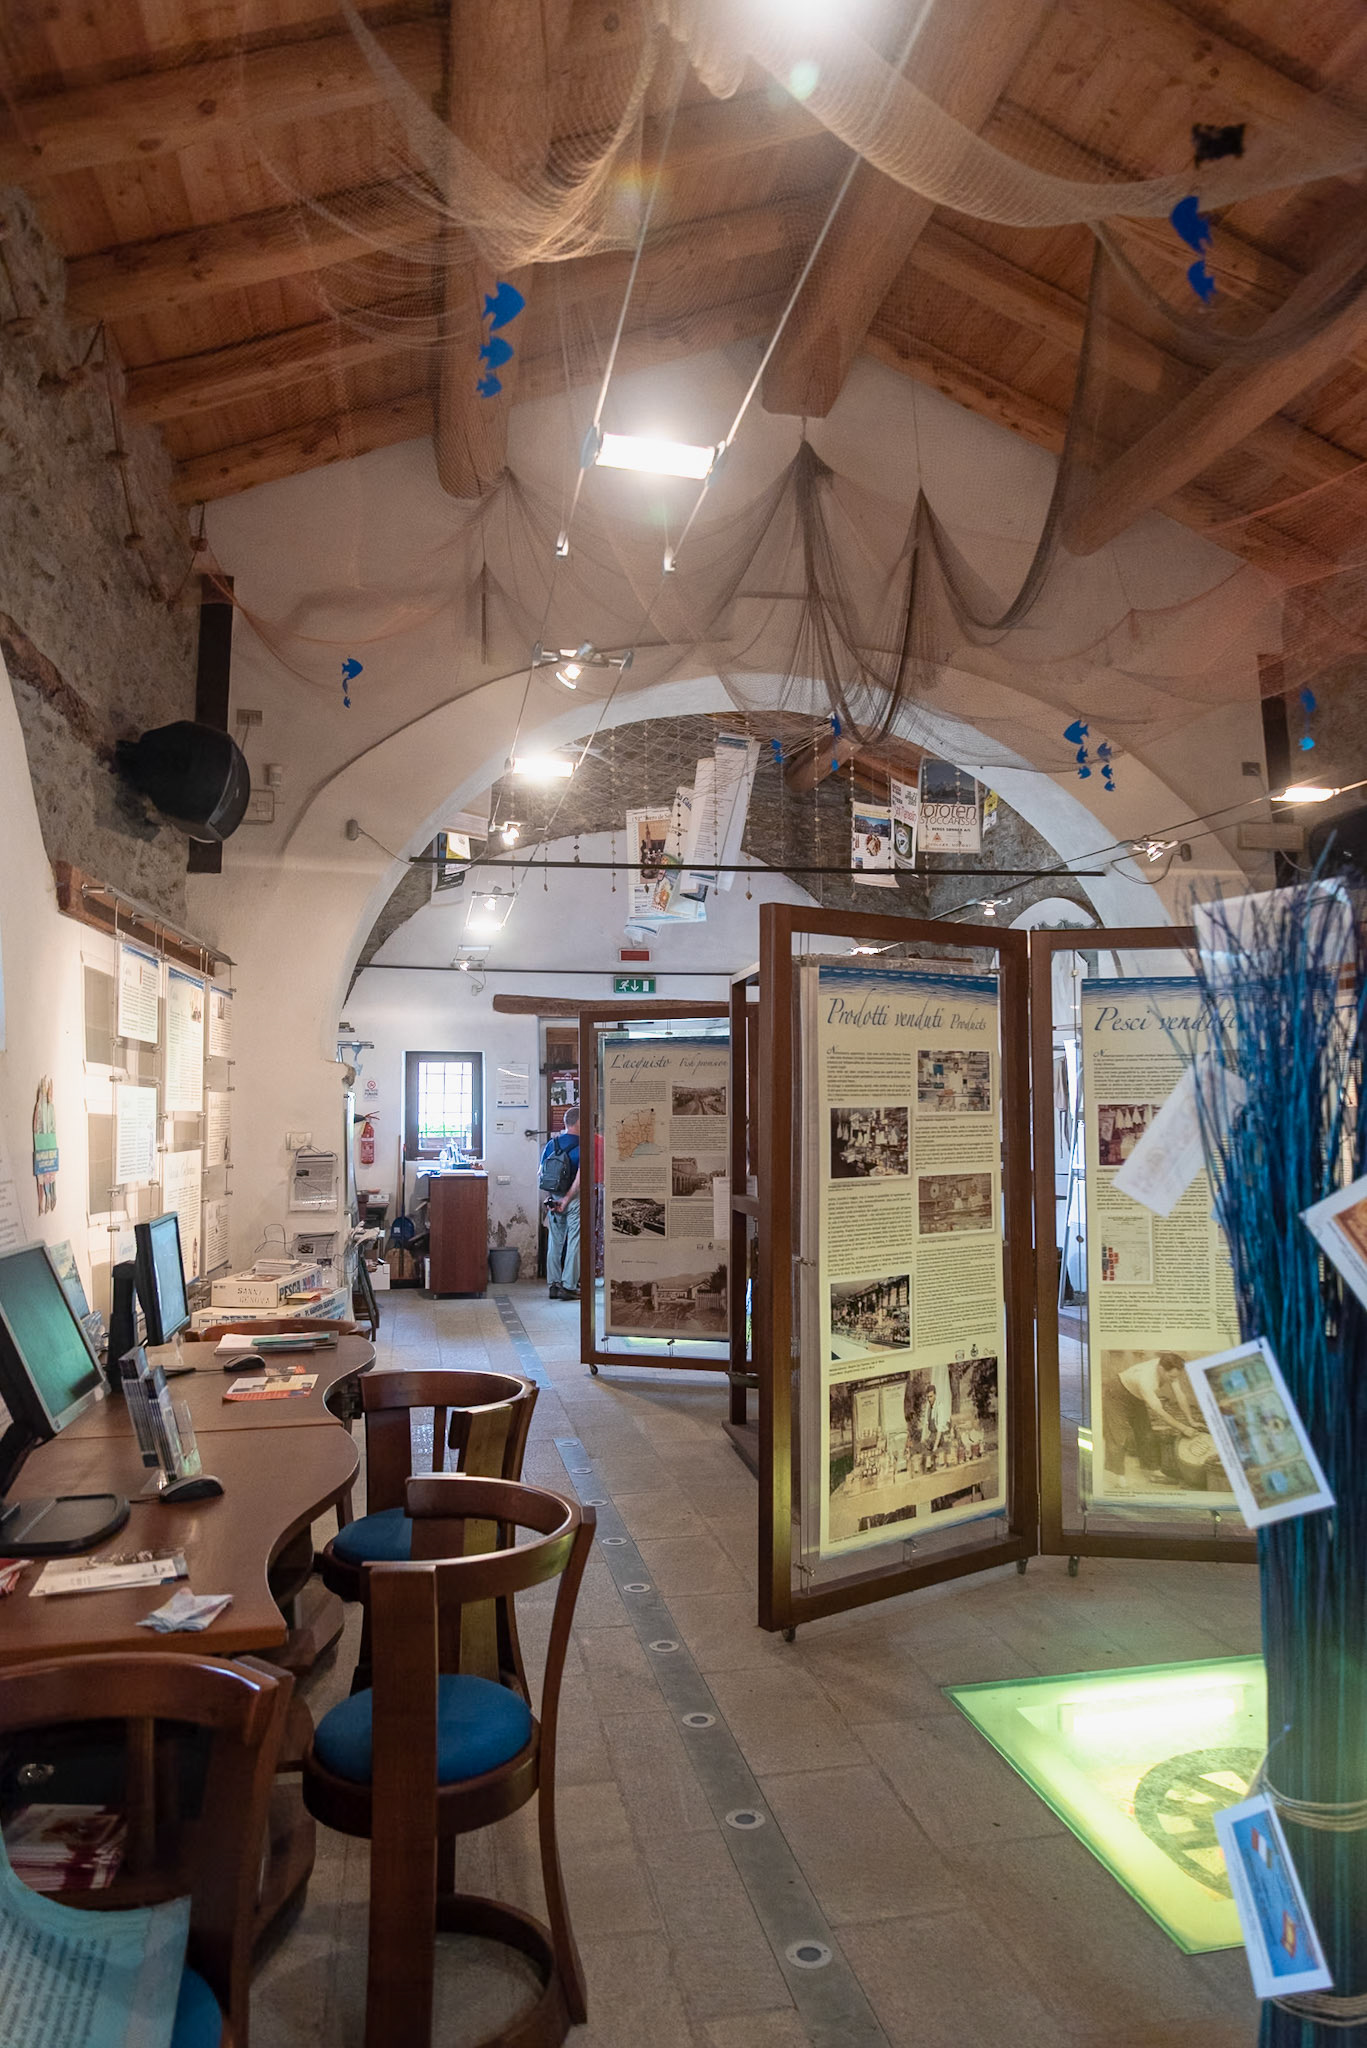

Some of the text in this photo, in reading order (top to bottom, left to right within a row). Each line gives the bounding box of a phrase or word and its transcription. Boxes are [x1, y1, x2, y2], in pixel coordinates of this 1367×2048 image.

[920, 801, 977, 819] lofoten
[827, 987, 987, 1031] Prodotti venduti Products
[1094, 1006, 1151, 1031] Pesci
[610, 1054, 672, 1083] L'acquisto
